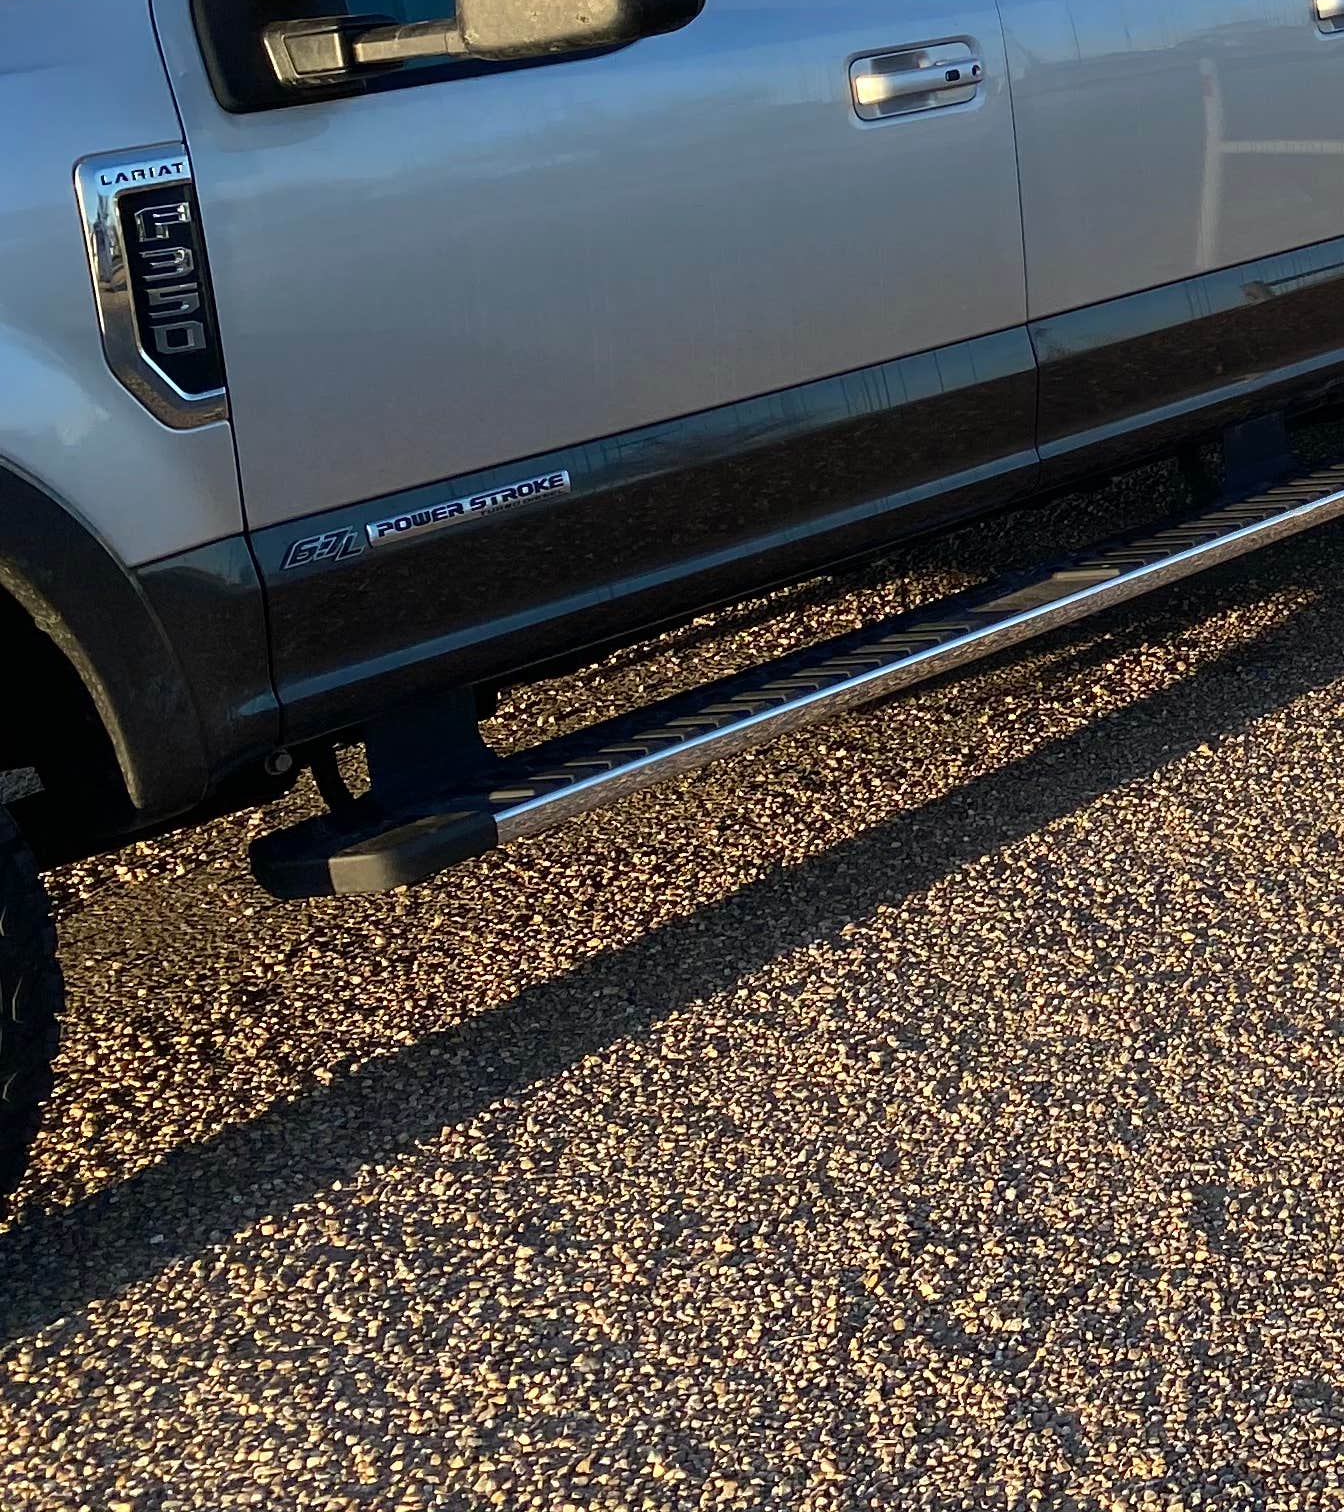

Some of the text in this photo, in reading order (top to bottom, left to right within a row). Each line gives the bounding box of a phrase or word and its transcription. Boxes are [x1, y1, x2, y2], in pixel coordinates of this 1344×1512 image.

[100, 161, 184, 186] LARIAT
[134, 202, 206, 355] F350
[376, 501, 464, 538] POWER
[469, 473, 564, 512] STROKE
